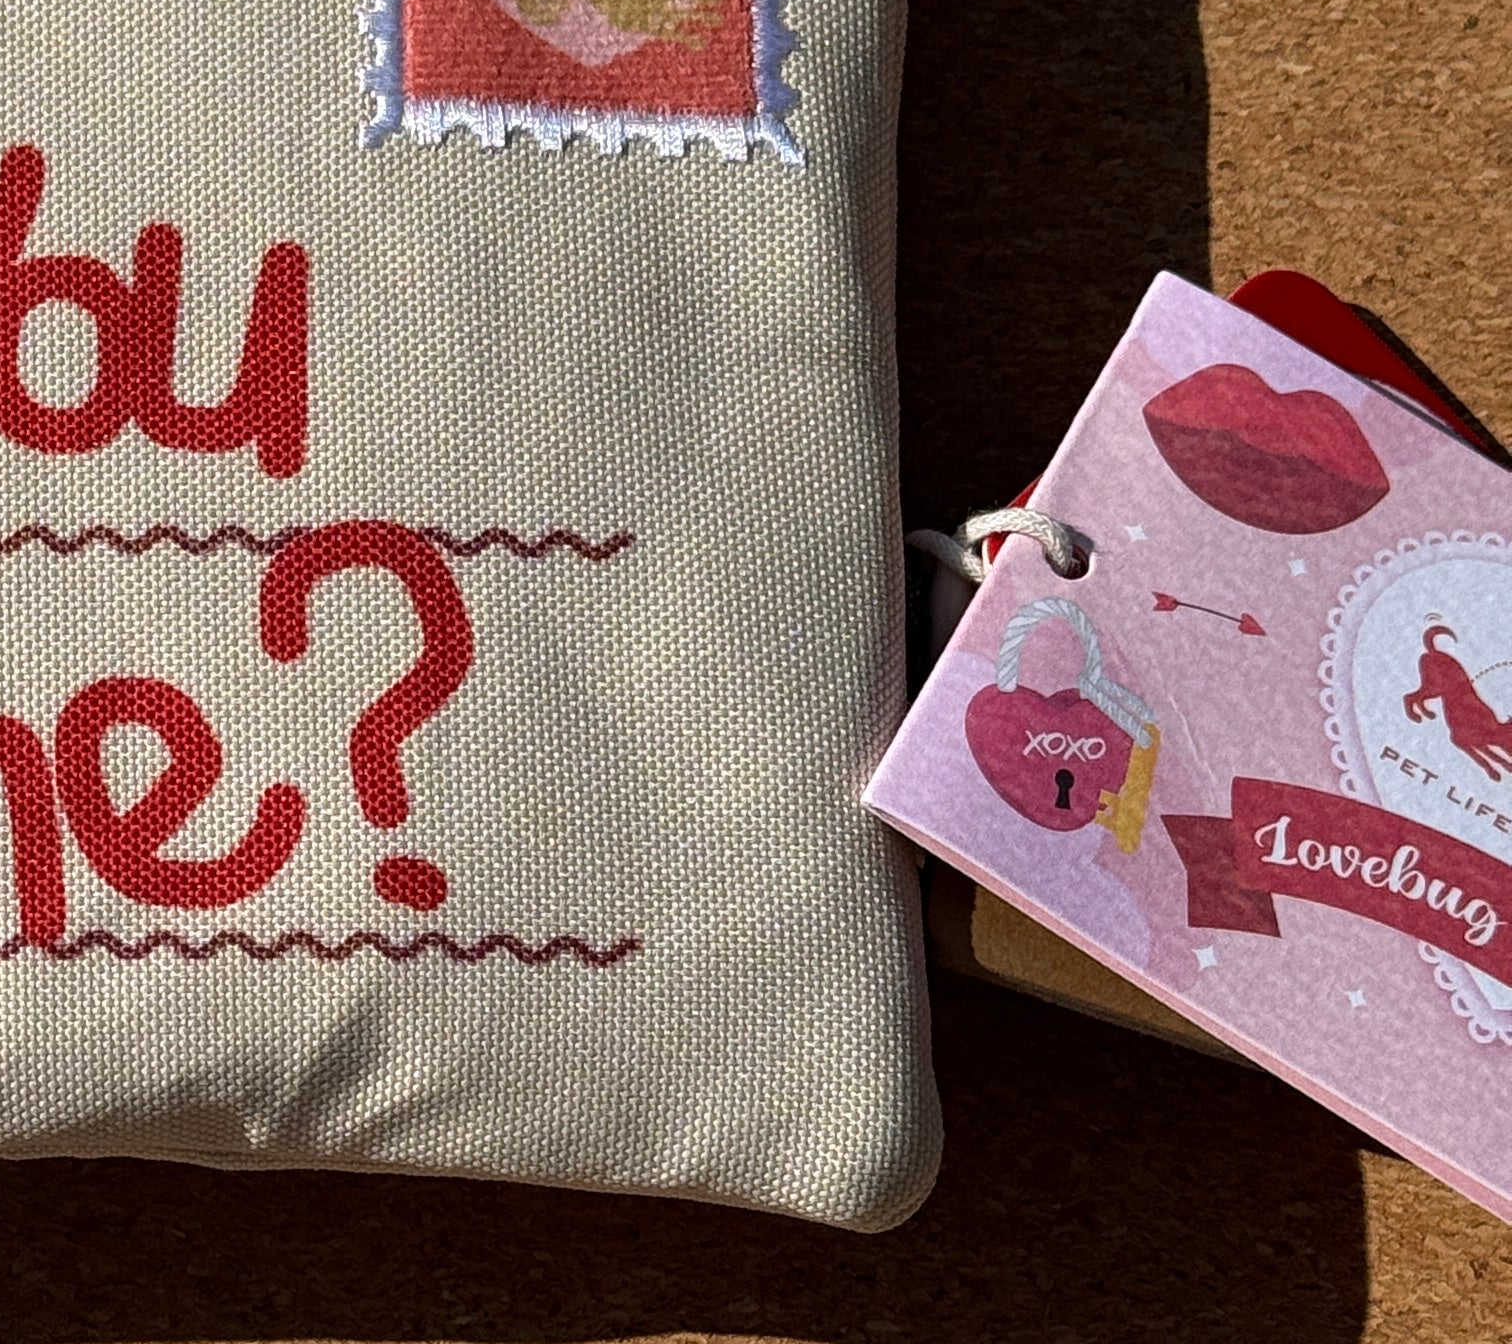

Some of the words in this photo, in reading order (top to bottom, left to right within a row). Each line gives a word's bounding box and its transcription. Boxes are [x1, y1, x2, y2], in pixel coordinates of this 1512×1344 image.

[1022, 729, 1107, 763] XOXO
[1379, 746, 1438, 786] PET
[1445, 785, 1512, 834] LIFE
[1254, 816, 1507, 946] Lovebug
